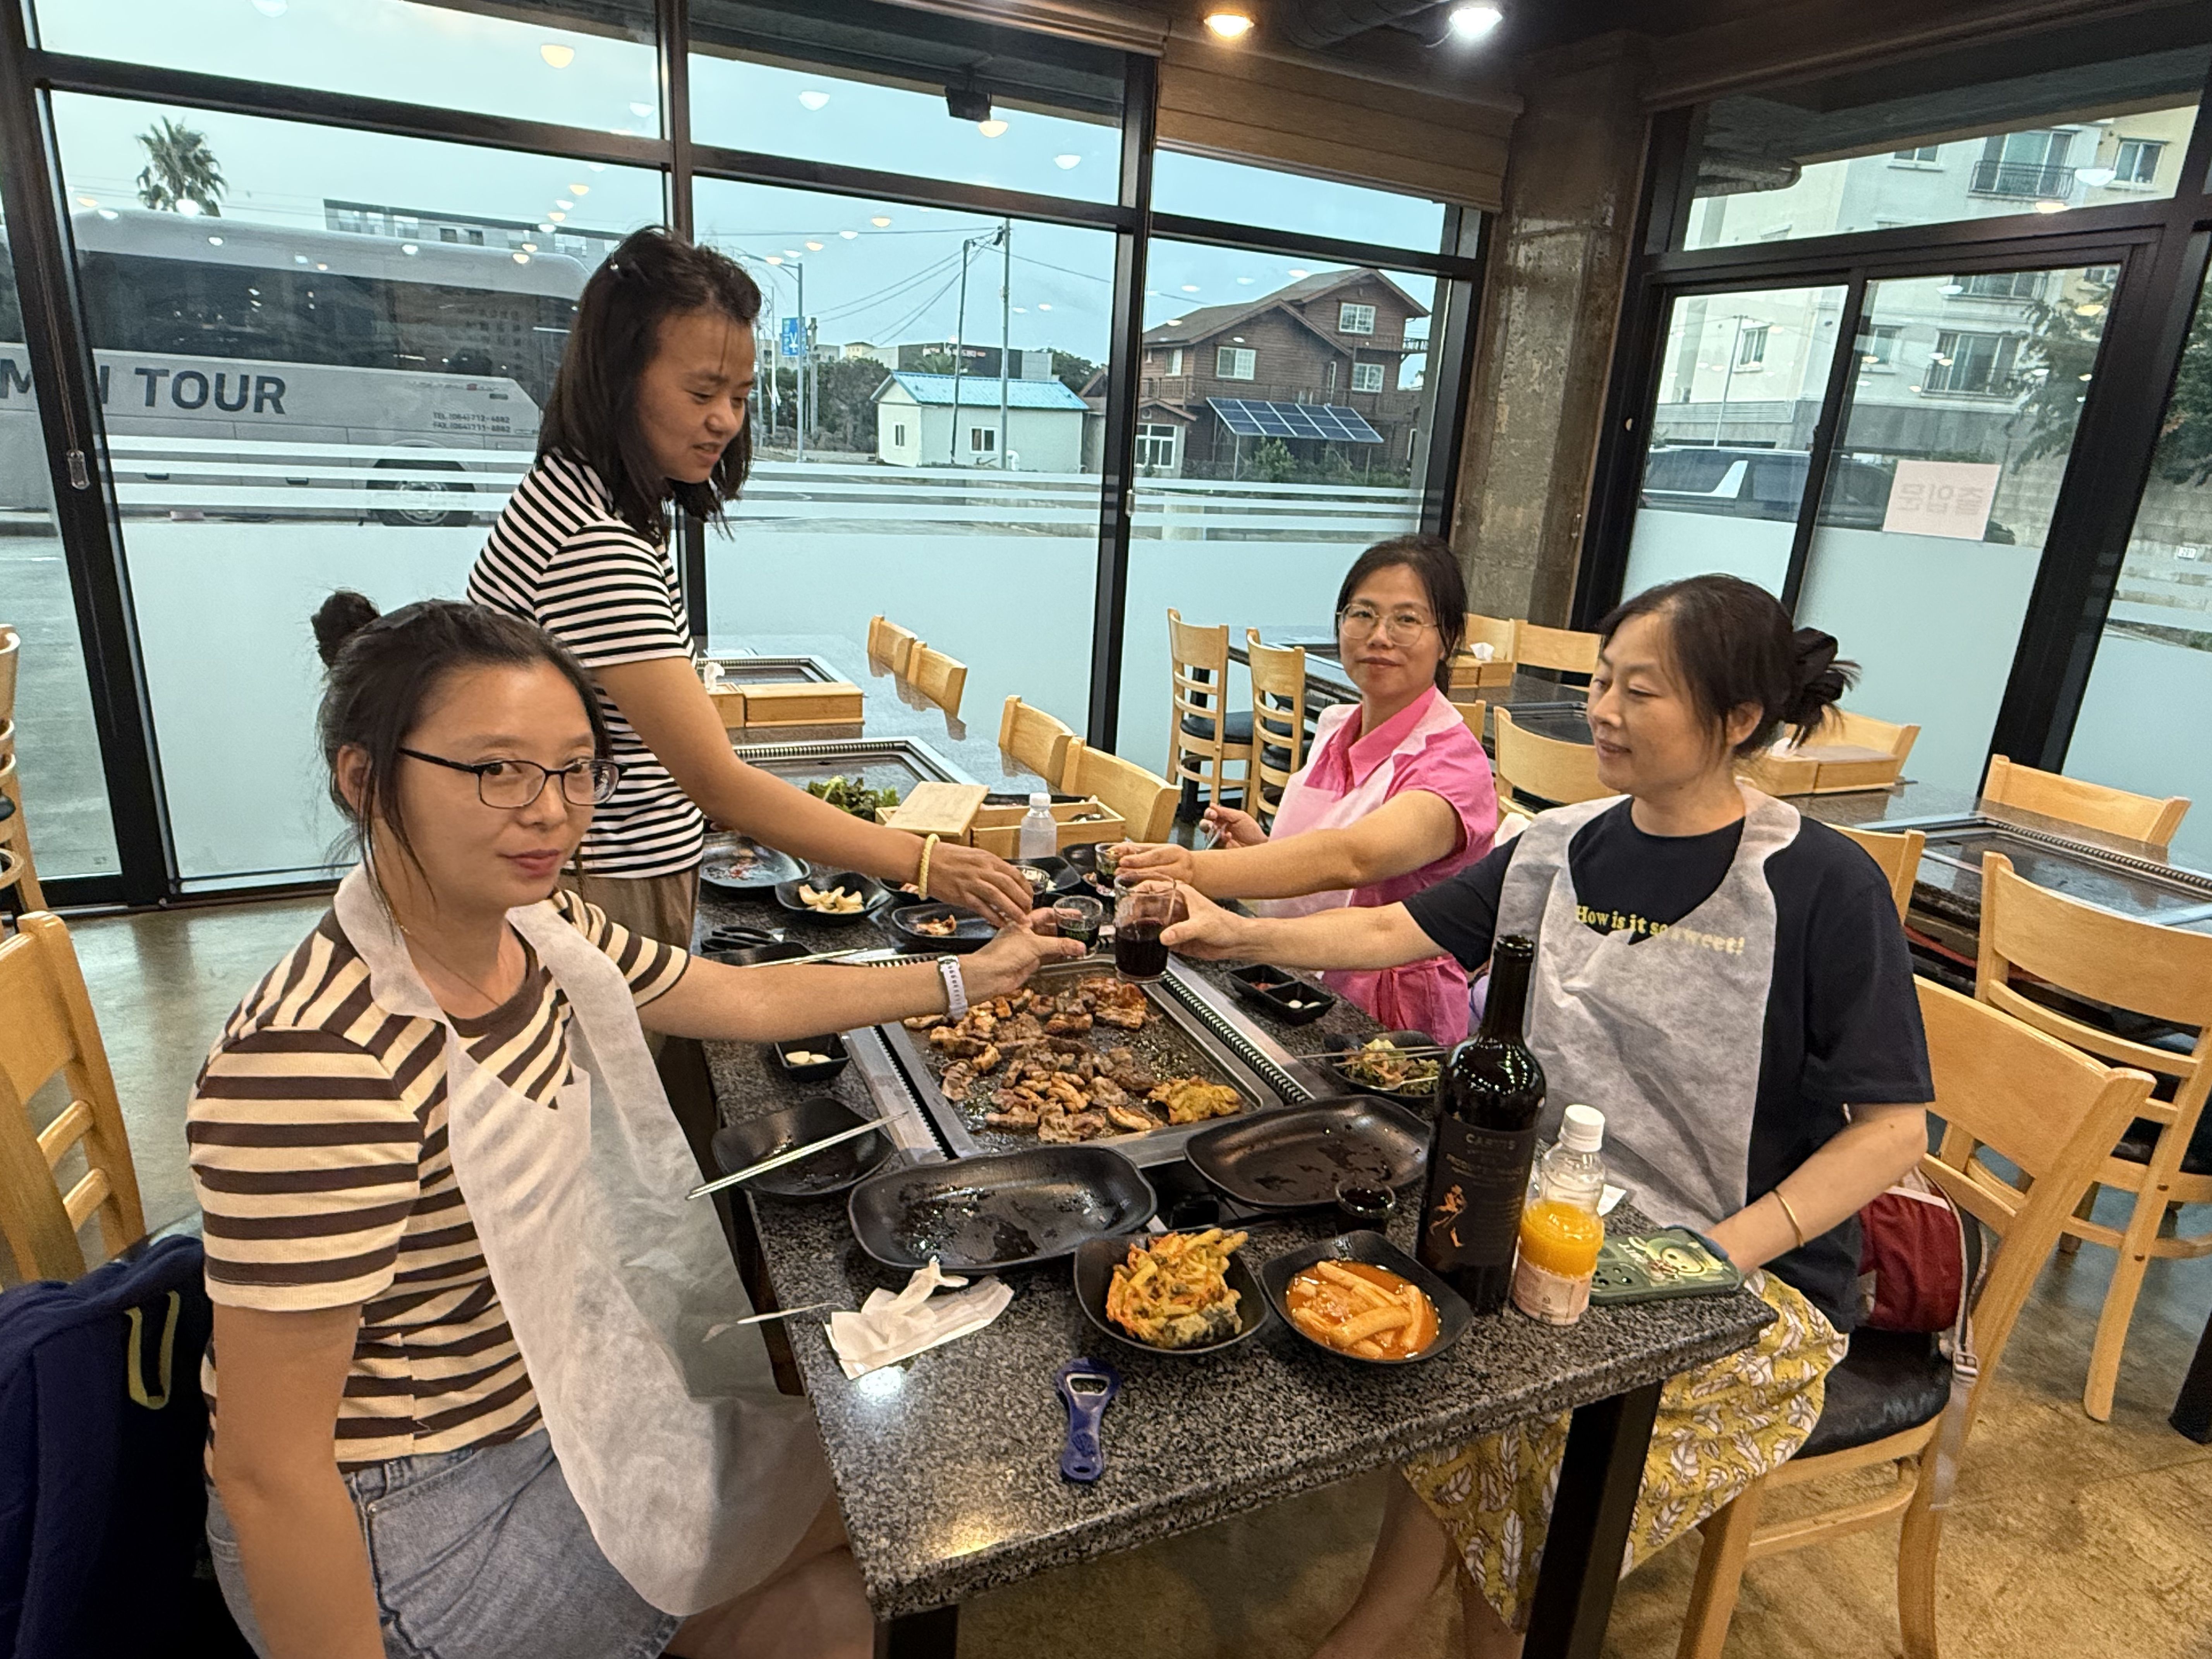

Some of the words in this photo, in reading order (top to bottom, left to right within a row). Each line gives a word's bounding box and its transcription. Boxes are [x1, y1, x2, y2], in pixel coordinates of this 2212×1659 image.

[134, 367, 286, 415] TOUR
[1577, 906, 1609, 925] How
[1611, 910, 1626, 929] is
[1629, 914, 1647, 934] it
[1650, 922, 1669, 935] so
